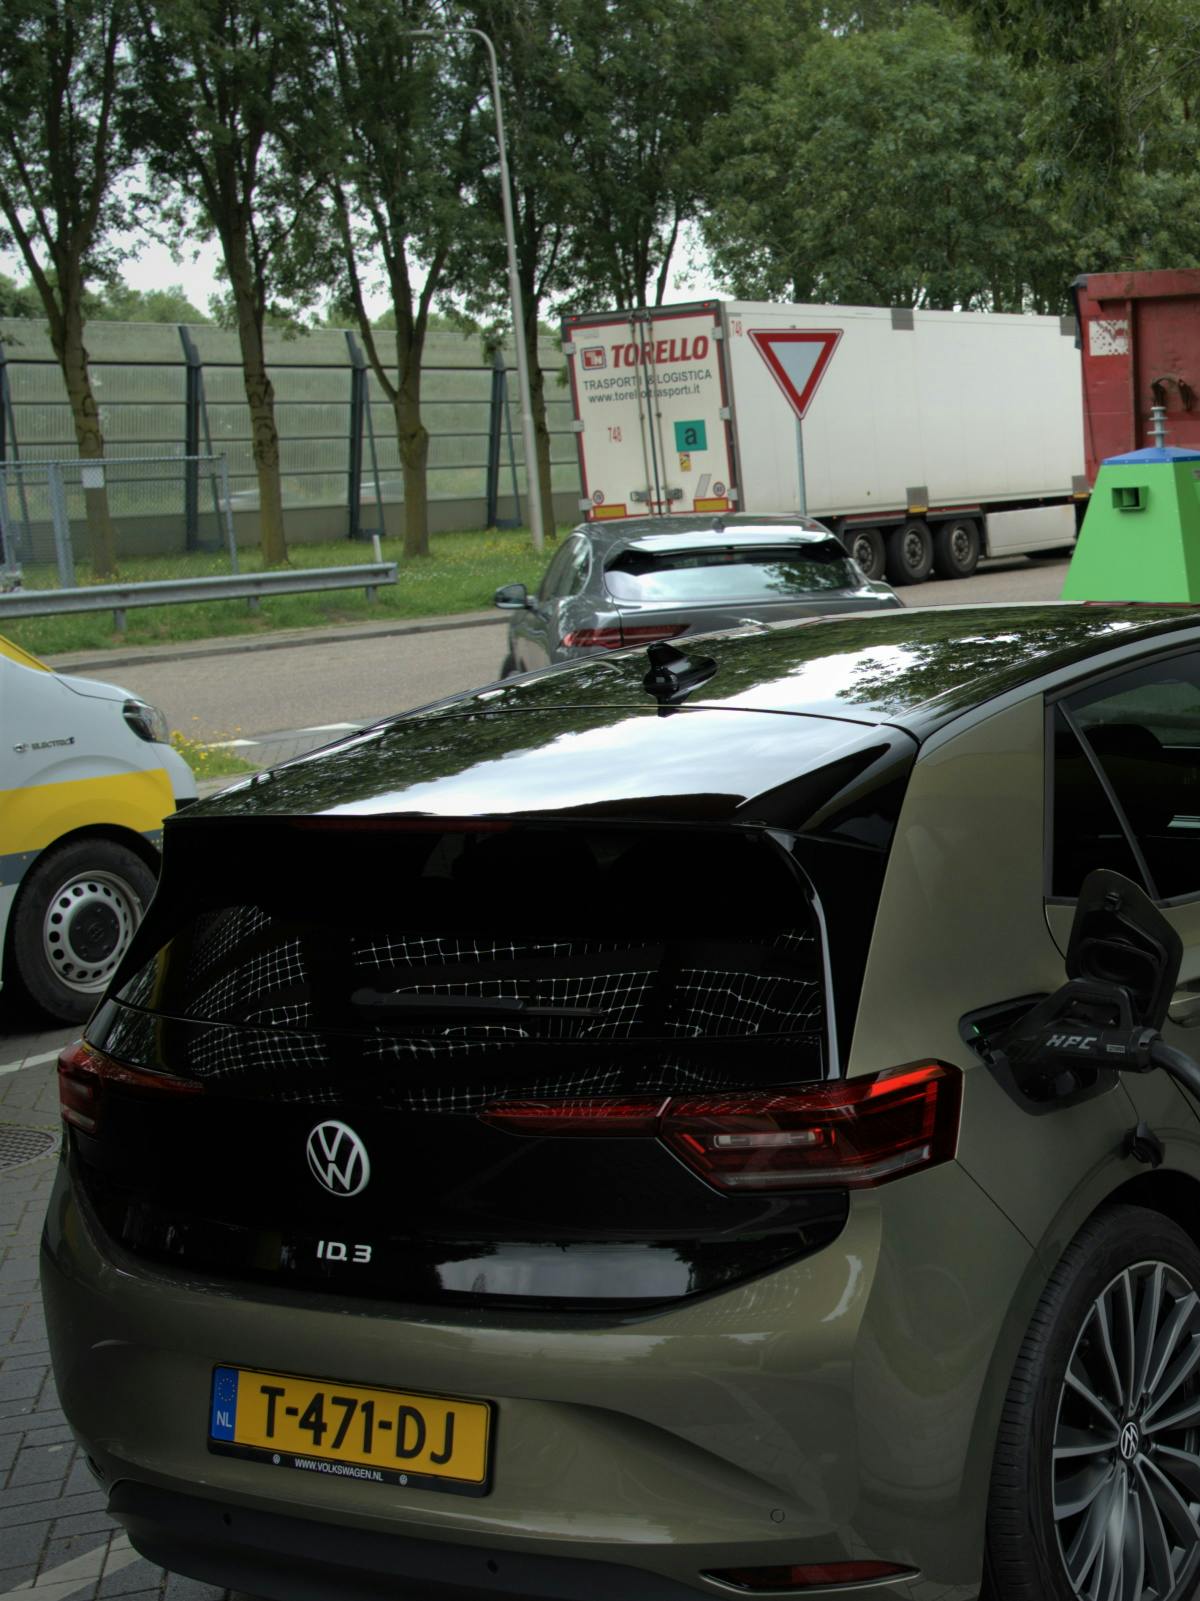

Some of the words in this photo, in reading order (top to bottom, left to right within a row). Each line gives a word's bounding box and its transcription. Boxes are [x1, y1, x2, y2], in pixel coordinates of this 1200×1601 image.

[611, 335, 709, 369] TORELLO
[658, 369, 713, 384] LOGISTICA
[684, 427, 698, 446] a
[1046, 1034, 1098, 1050] HPC
[216, 1410, 233, 1429] NL
[260, 1384, 456, 1465] T-471-DJ
[295, 1457, 384, 1483] WWW.VOLKSWAGEN.NL
